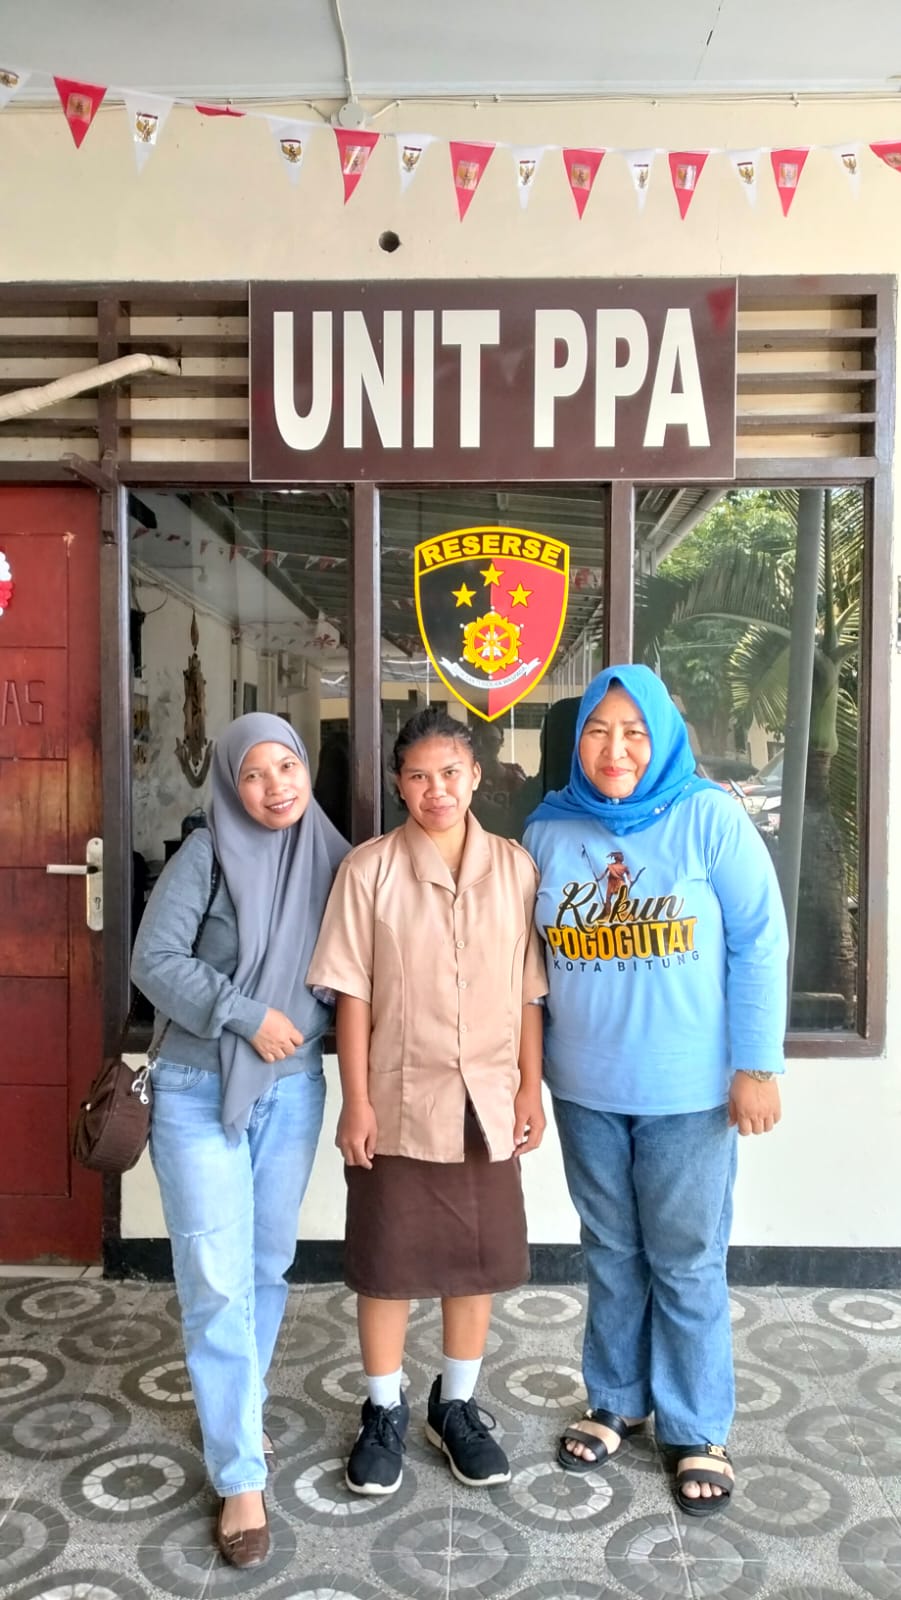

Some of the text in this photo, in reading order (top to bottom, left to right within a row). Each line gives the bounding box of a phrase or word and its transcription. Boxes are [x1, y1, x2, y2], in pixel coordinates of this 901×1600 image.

[273, 307, 711, 451] UNIT PPA
[420, 534, 562, 567] RESERSE
[555, 881, 685, 934] Rukun
[543, 916, 698, 961] POGOGUTAT
[553, 950, 700, 972] KOTA BITUNG
